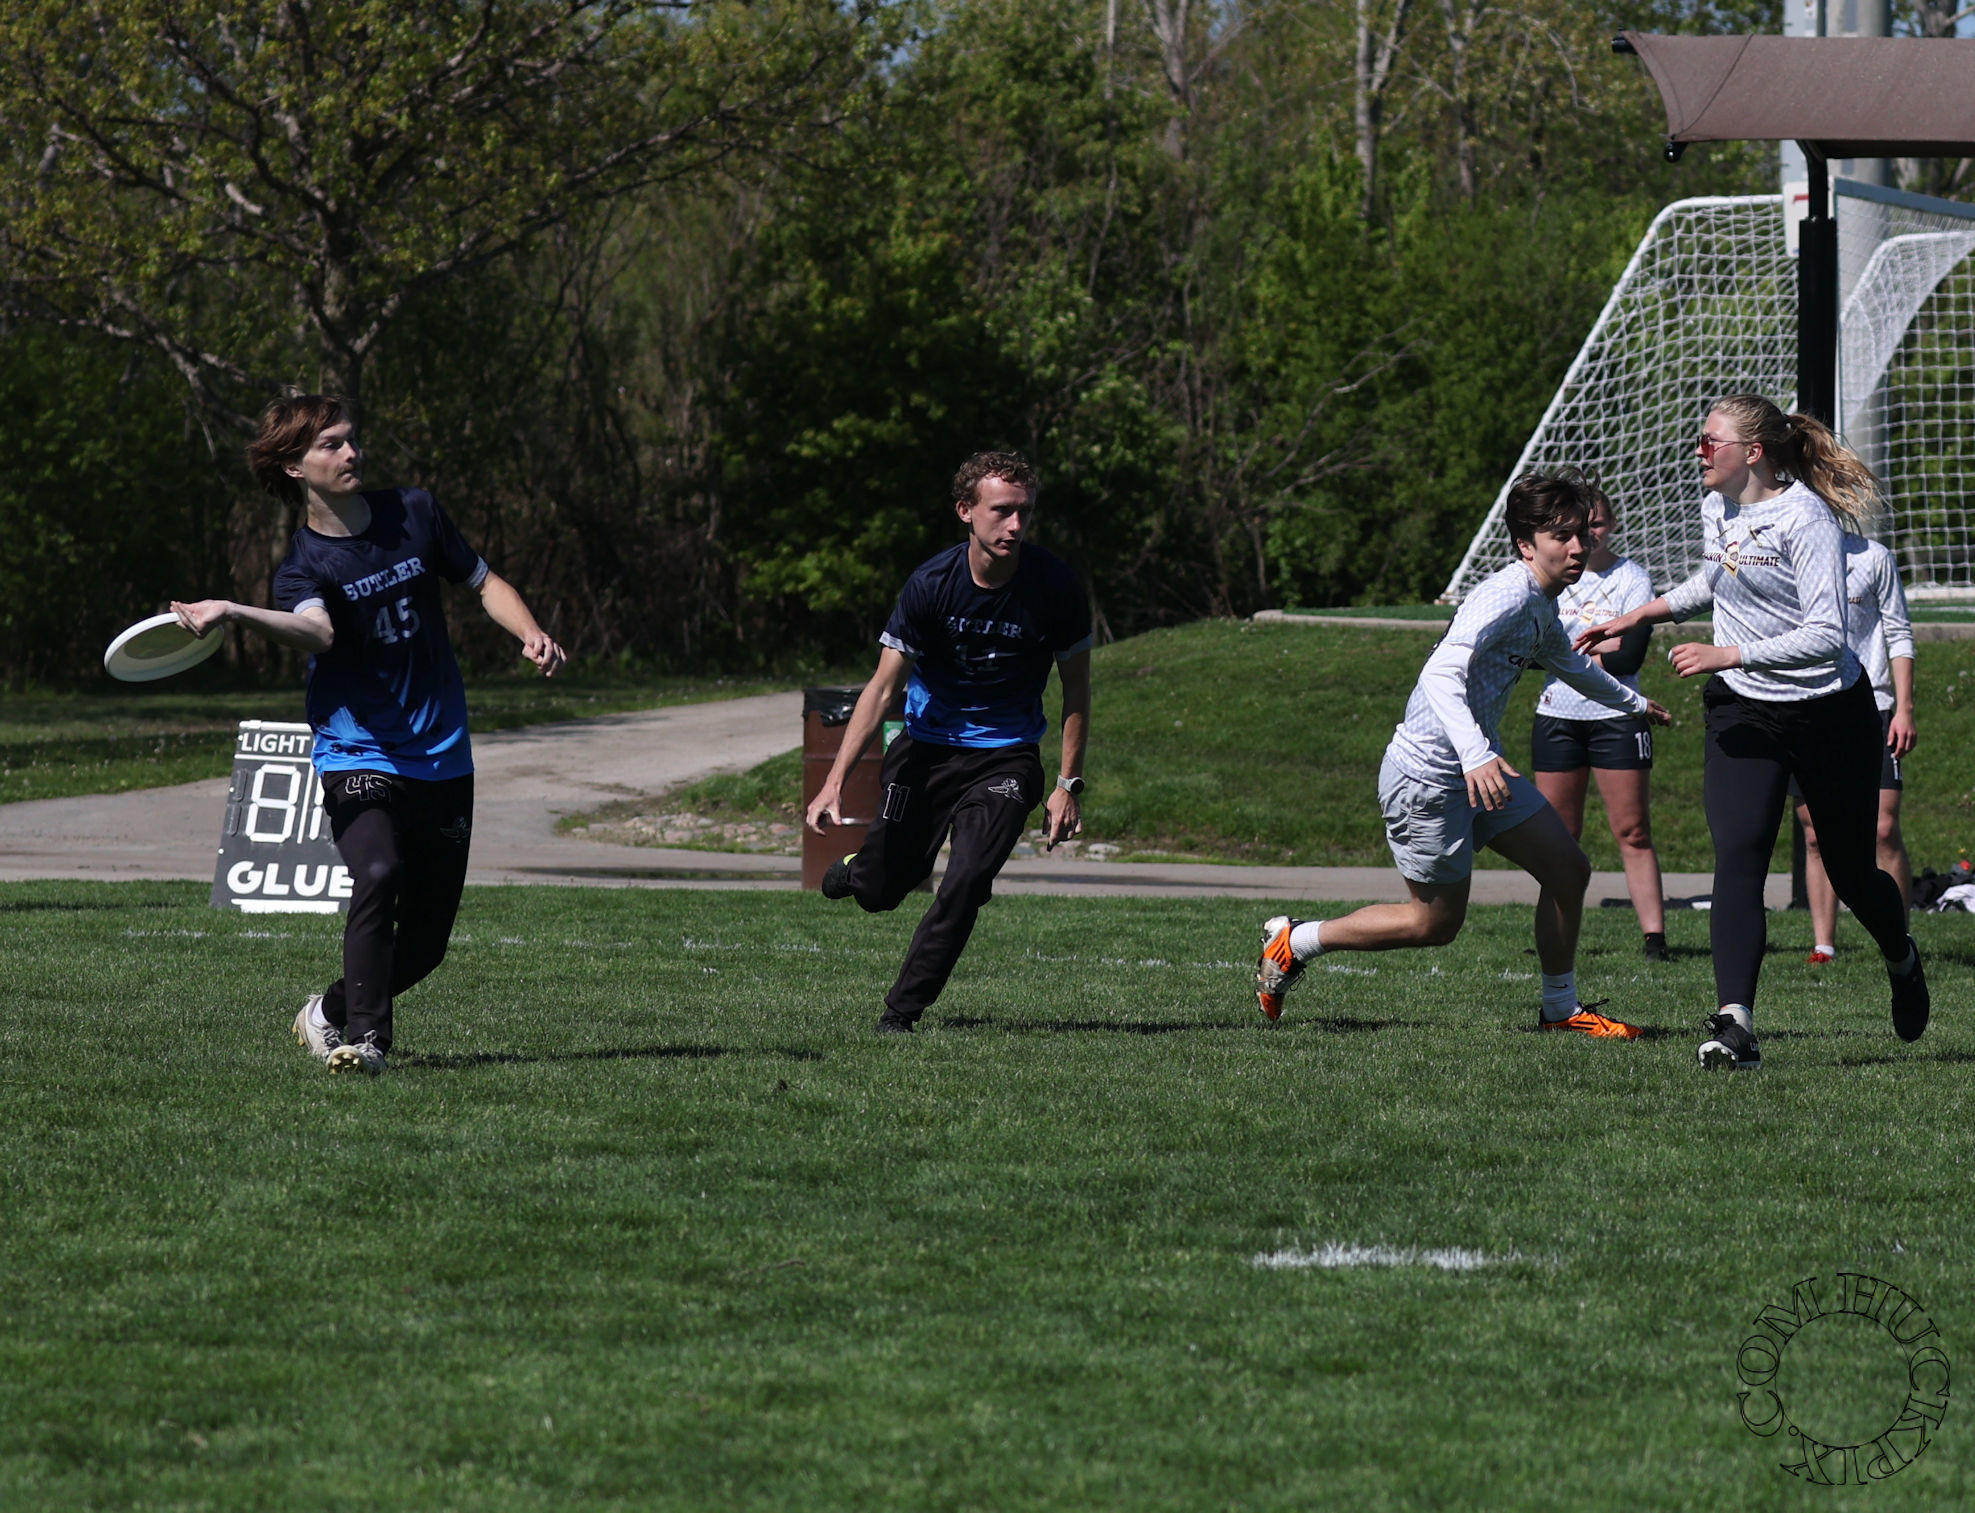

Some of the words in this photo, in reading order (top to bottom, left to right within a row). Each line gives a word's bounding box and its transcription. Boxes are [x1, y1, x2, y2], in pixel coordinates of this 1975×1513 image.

[1739, 554, 1781, 567] ULTIMATE
[342, 557, 426, 601] BUTLER
[373, 596, 420, 644] 45
[240, 733, 310, 754] LIGHT
[1634, 731, 1651, 760] 18
[345, 774, 393, 802] 45
[882, 783, 911, 822] 11
